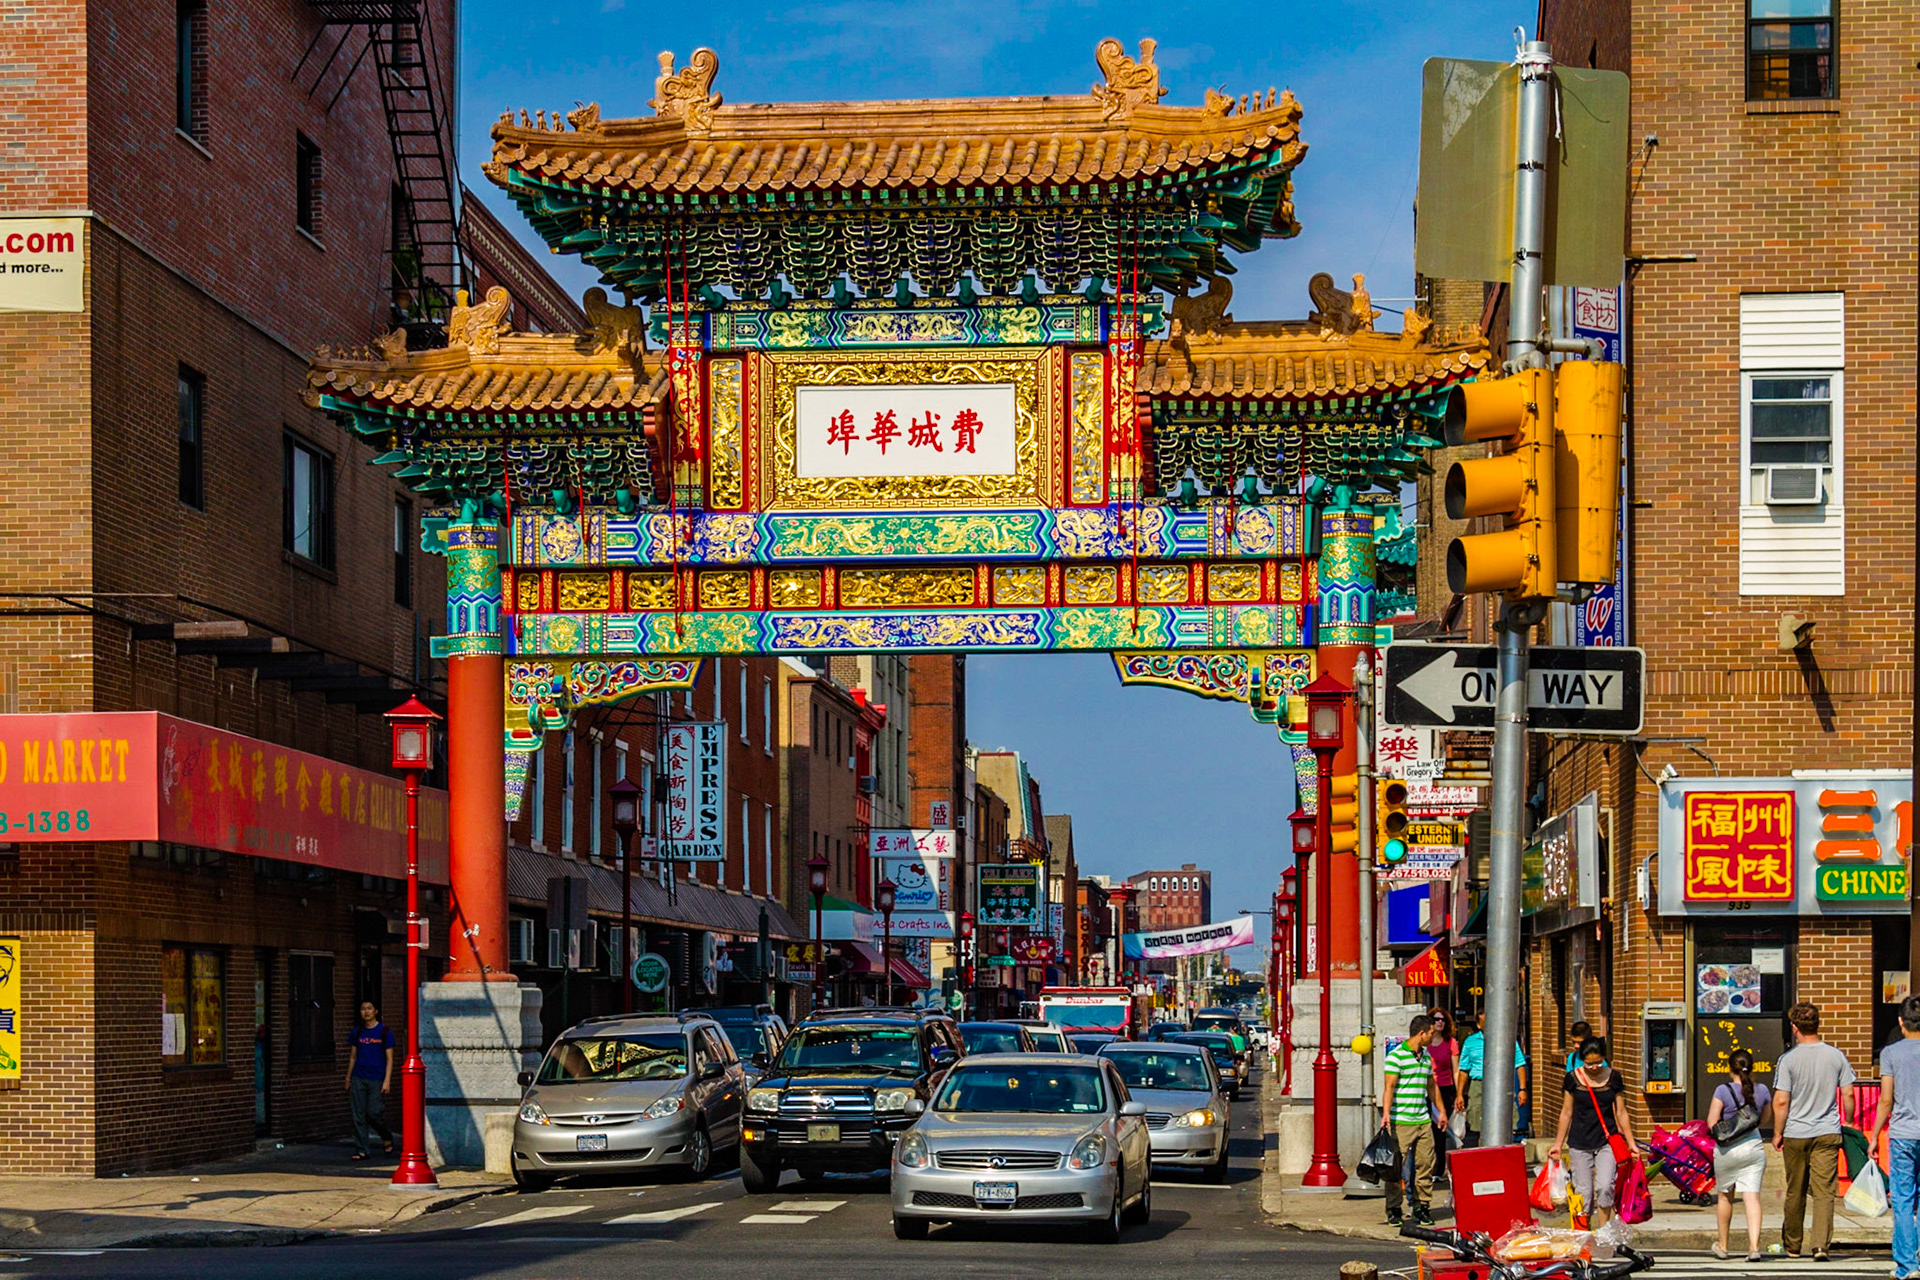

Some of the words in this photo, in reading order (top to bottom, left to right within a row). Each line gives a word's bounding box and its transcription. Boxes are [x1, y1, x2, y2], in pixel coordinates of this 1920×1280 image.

[11, 263, 64, 273] more...
[1461, 671, 1497, 703] ON
[1542, 673, 1614, 705] WAY
[22, 738, 130, 784] MARKET
[1416, 760, 1432, 768] Law
[1406, 768, 1433, 778] Gregory
[700, 725, 718, 841] EMPRESS
[1416, 834, 1451, 844] UNION
[660, 844, 722, 857] GARDEN
[1727, 900, 1752, 911] 935
[873, 919, 896, 930] Asa
[898, 918, 931, 932] Crafts
[1408, 971, 1428, 985] SIU
[1065, 996, 1104, 1005] Dunbar
